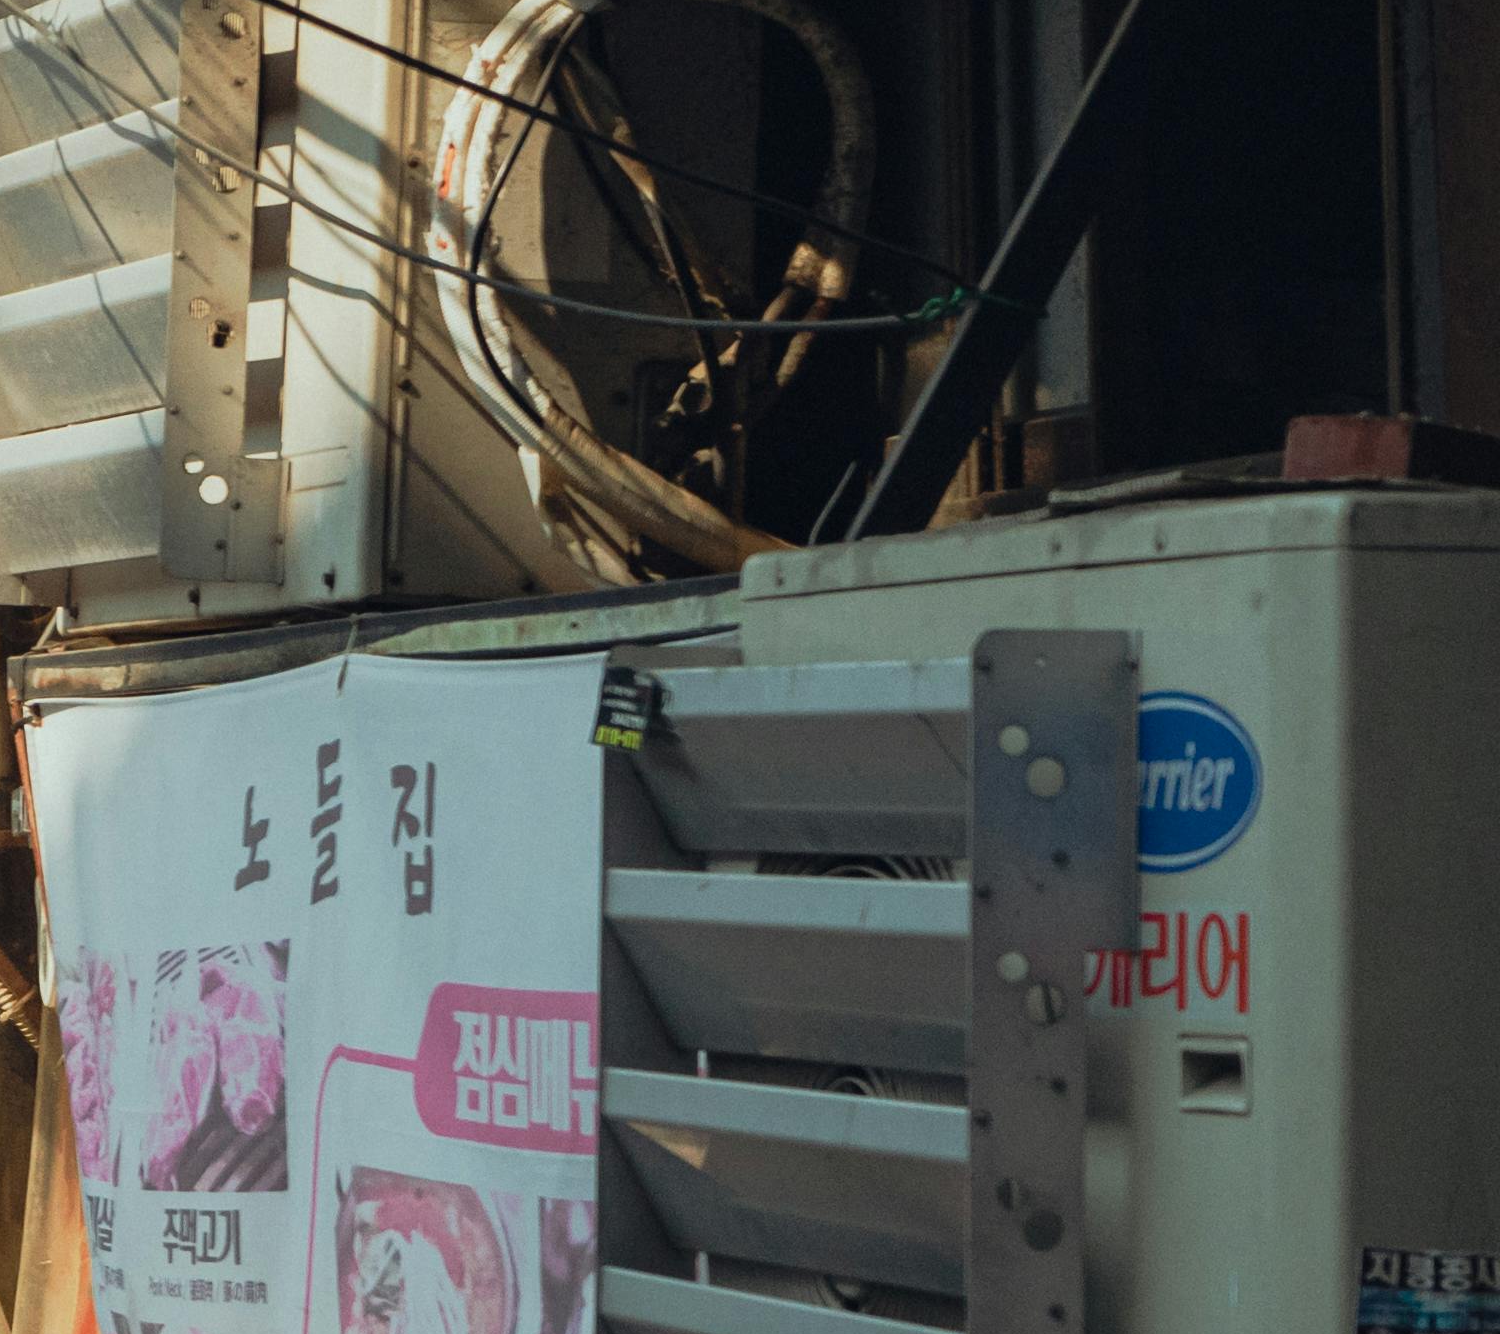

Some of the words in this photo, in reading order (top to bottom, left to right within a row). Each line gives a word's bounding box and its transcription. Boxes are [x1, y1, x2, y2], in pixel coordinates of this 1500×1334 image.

[1138, 741, 1235, 811] rrier
[234, 738, 437, 917] 노들집
[162, 1208, 242, 1266] 주먹고기
